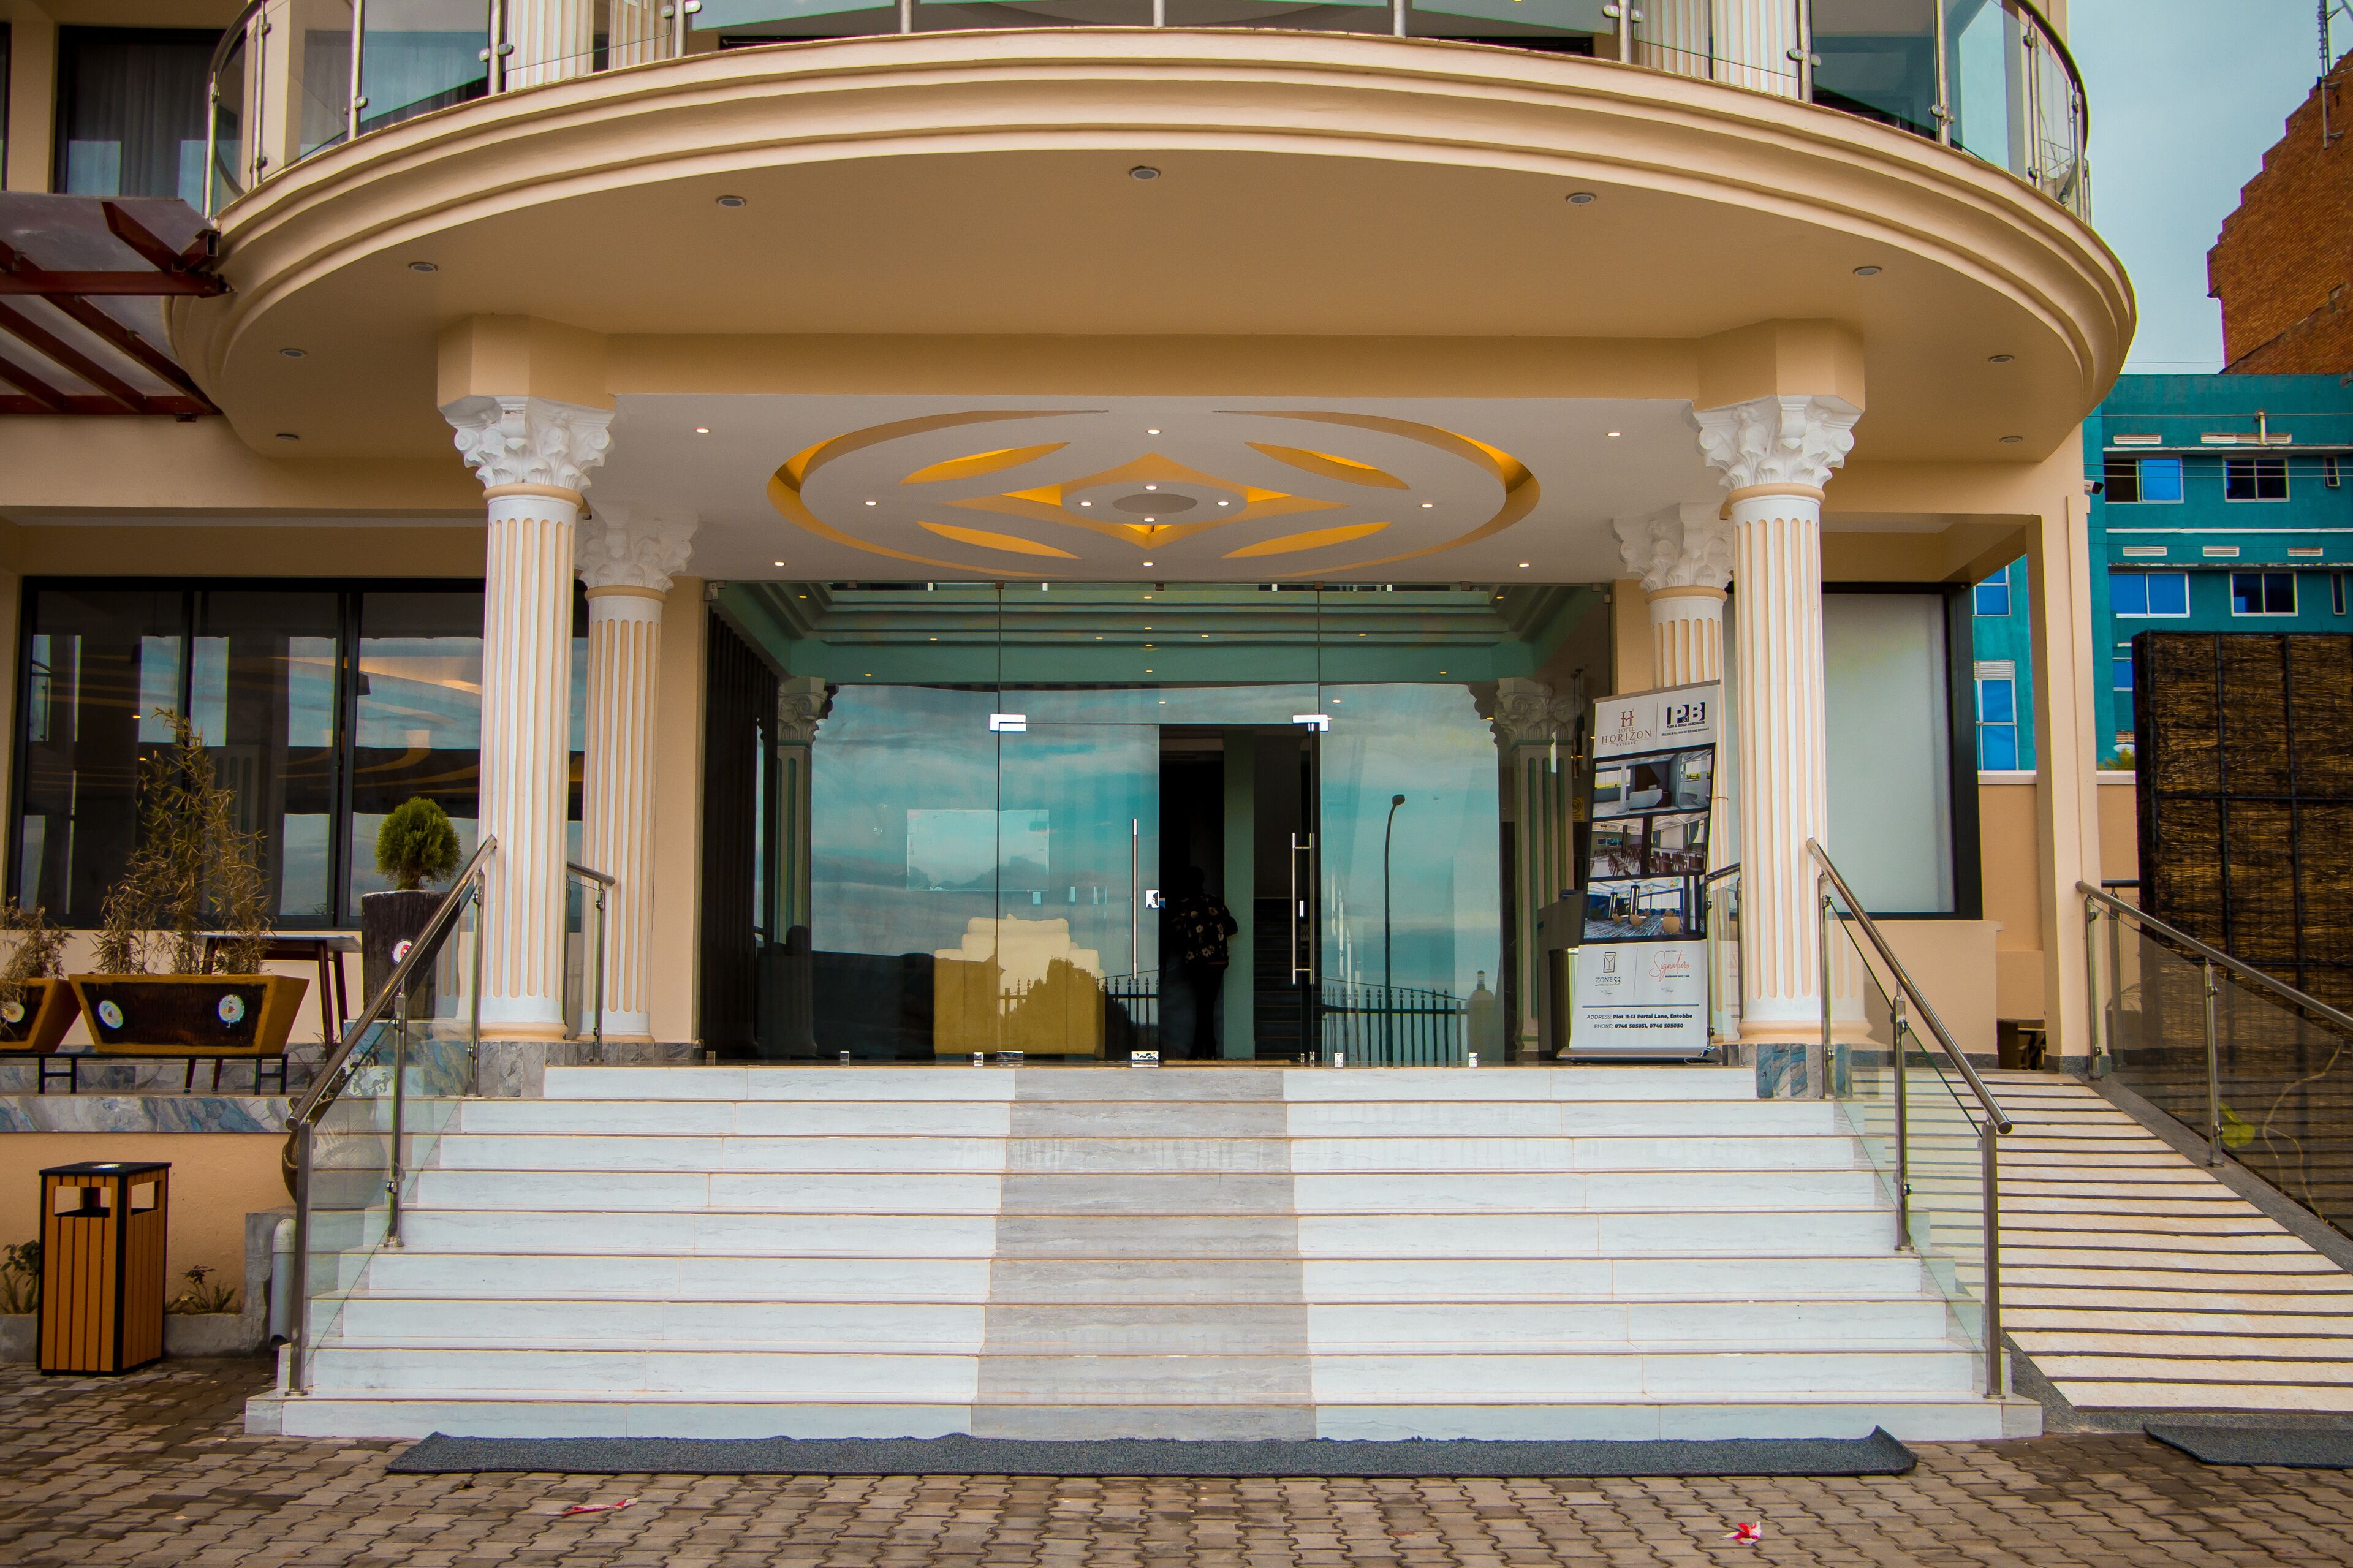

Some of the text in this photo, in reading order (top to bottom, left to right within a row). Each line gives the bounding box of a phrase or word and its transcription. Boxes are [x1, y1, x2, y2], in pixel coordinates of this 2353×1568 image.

[1601, 729, 1652, 744] HORIZON
[1649, 950, 1691, 982] Signature
[1613, 976, 1621, 985] 53
